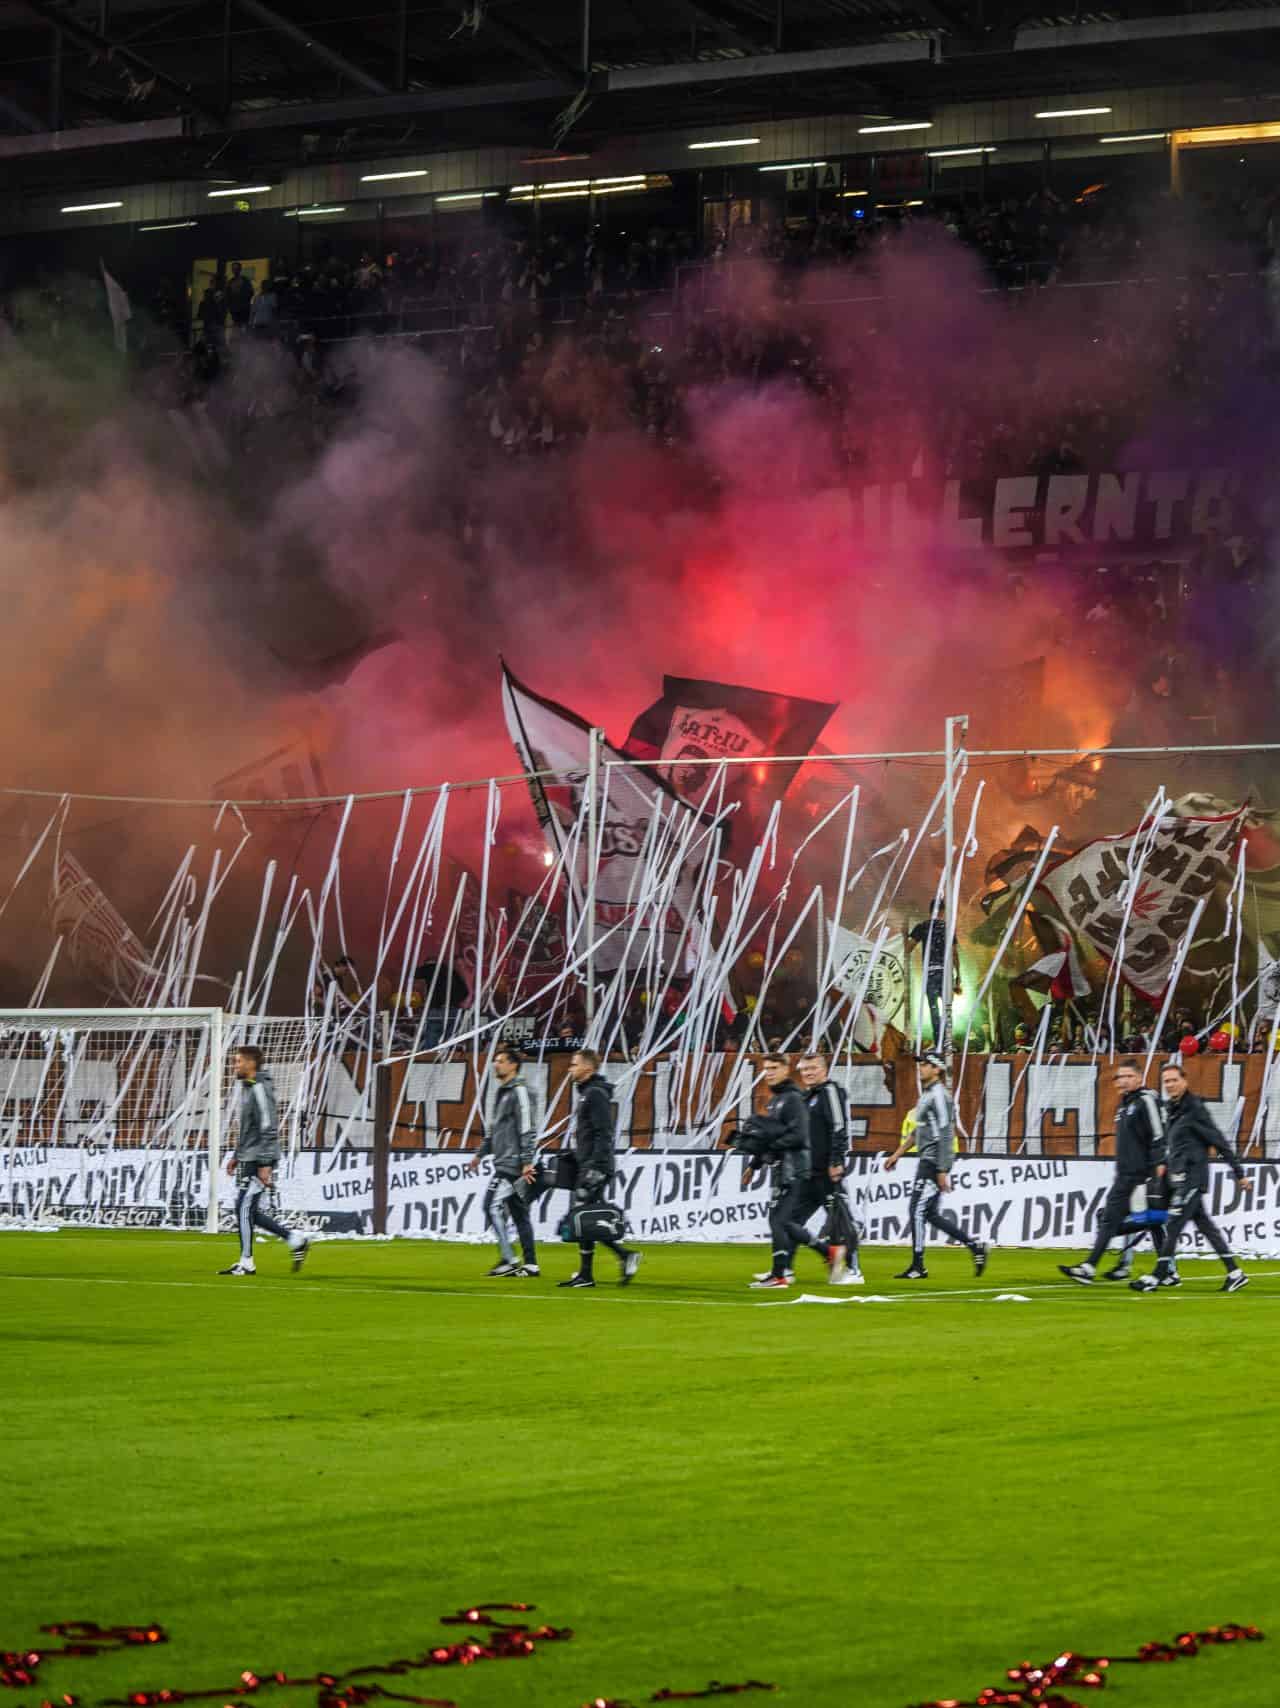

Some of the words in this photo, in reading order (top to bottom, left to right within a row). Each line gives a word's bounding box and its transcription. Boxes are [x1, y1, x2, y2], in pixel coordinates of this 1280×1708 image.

[389, 1168, 420, 1190] AIR
[426, 1158, 497, 1183] SPORTS
[978, 1169, 1005, 1188] ST.
[1011, 1160, 1068, 1184] PAULI
[1243, 1222, 1267, 1242] FC
